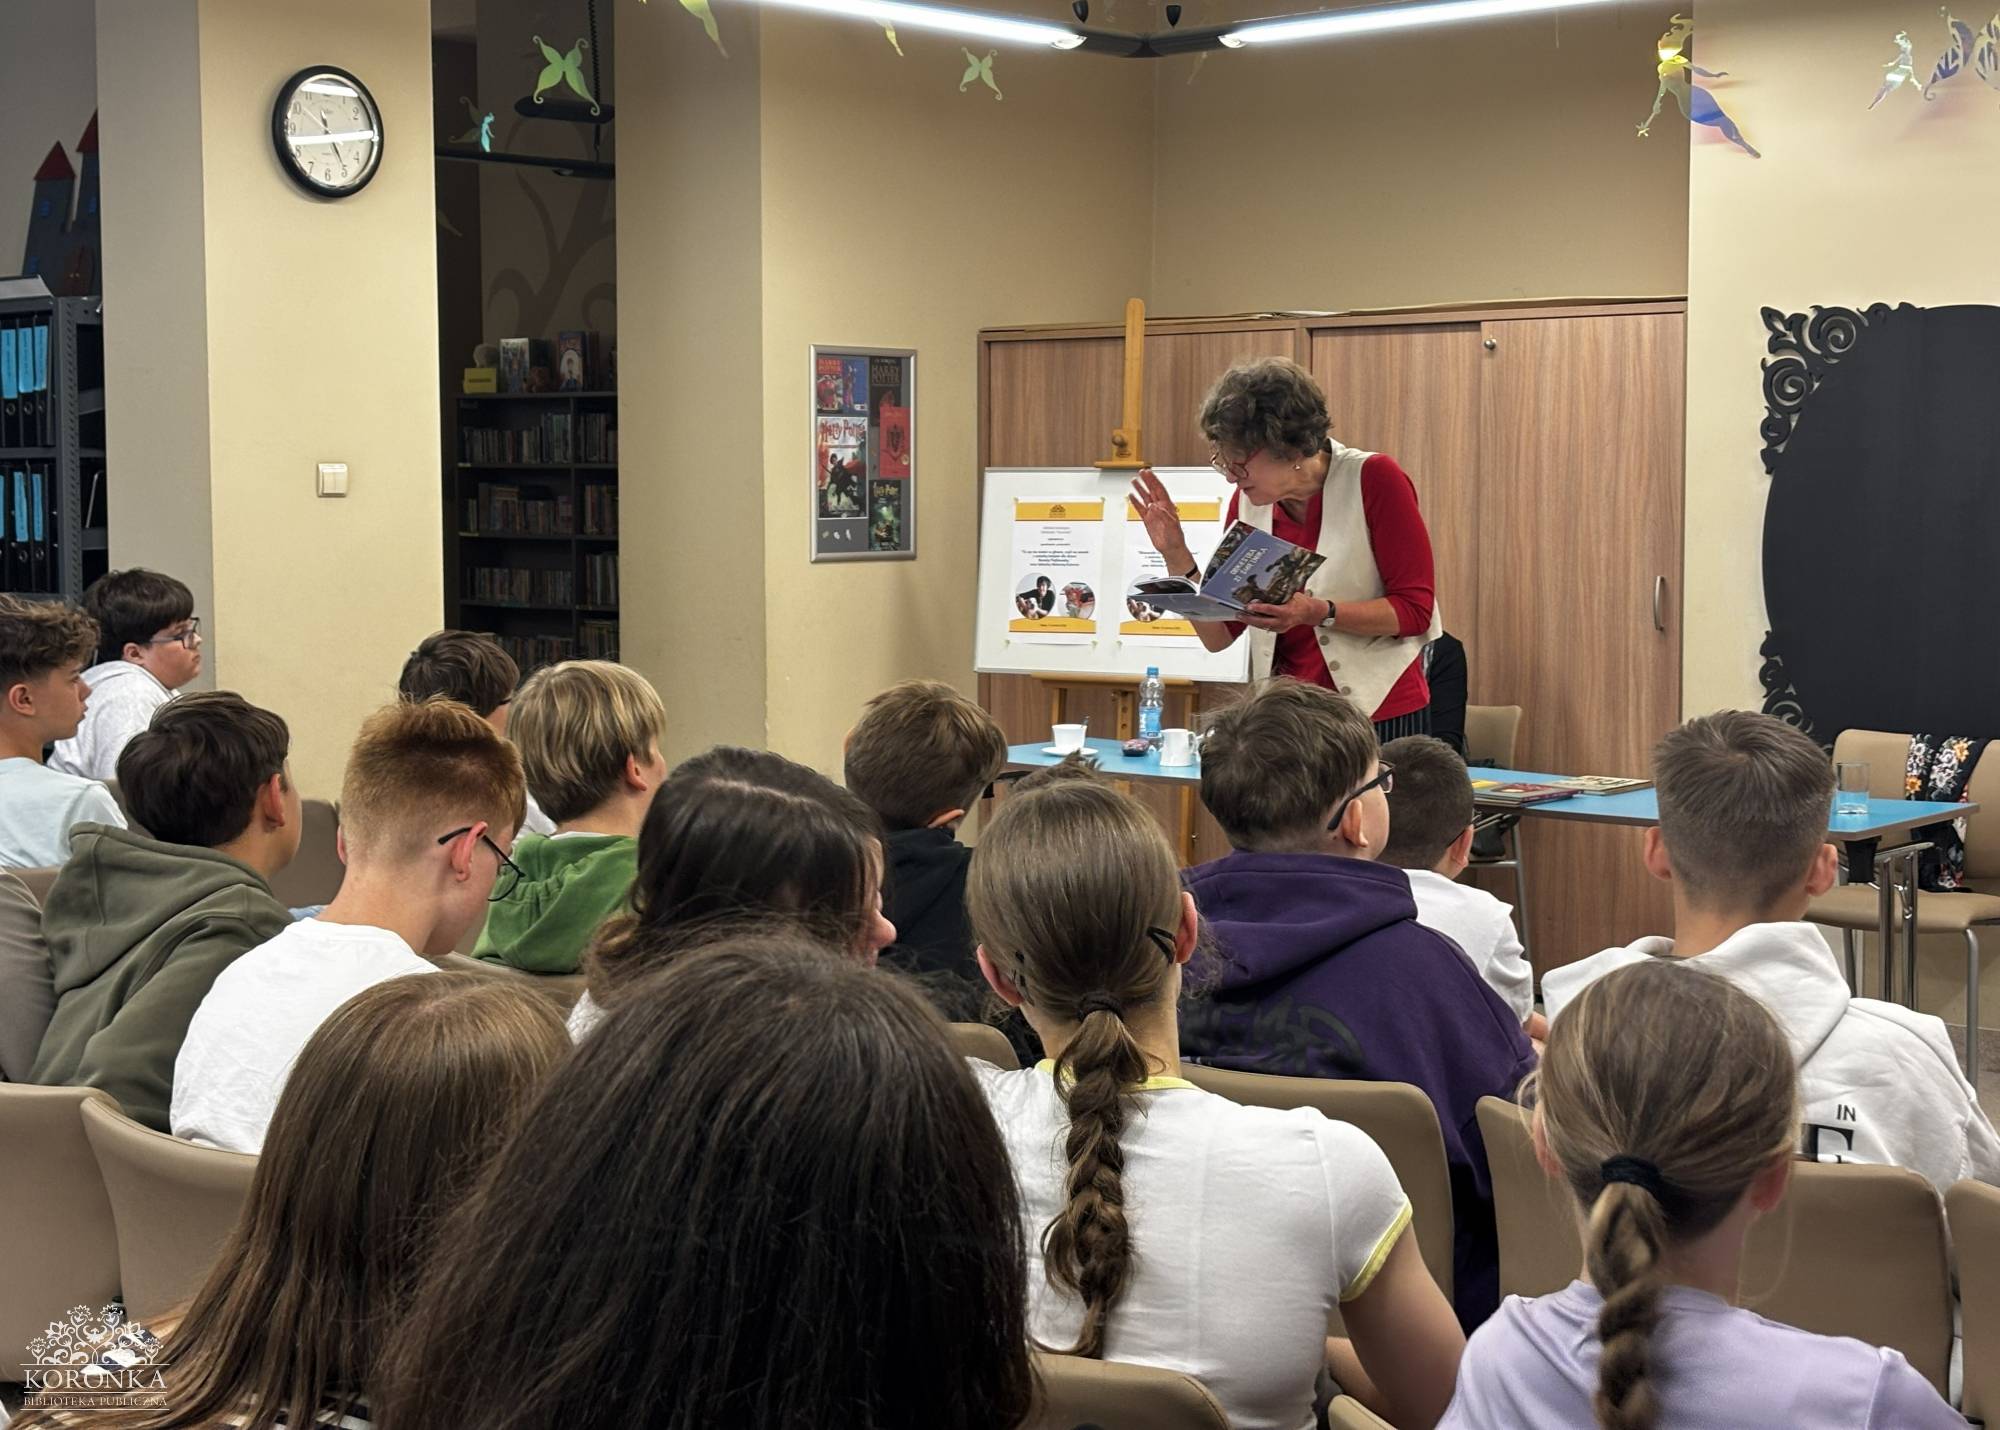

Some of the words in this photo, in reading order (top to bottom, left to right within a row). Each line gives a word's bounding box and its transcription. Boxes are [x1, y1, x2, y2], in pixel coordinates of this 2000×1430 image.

[293, 102, 302, 115] 10
[352, 107, 360, 120] 2
[289, 122, 297, 135] 9
[294, 145, 302, 158] 8
[353, 151, 360, 164] 4
[307, 161, 314, 174] 7
[340, 164, 348, 178] 5
[324, 168, 331, 181] 6
[1836, 1103, 1857, 1122] IN
